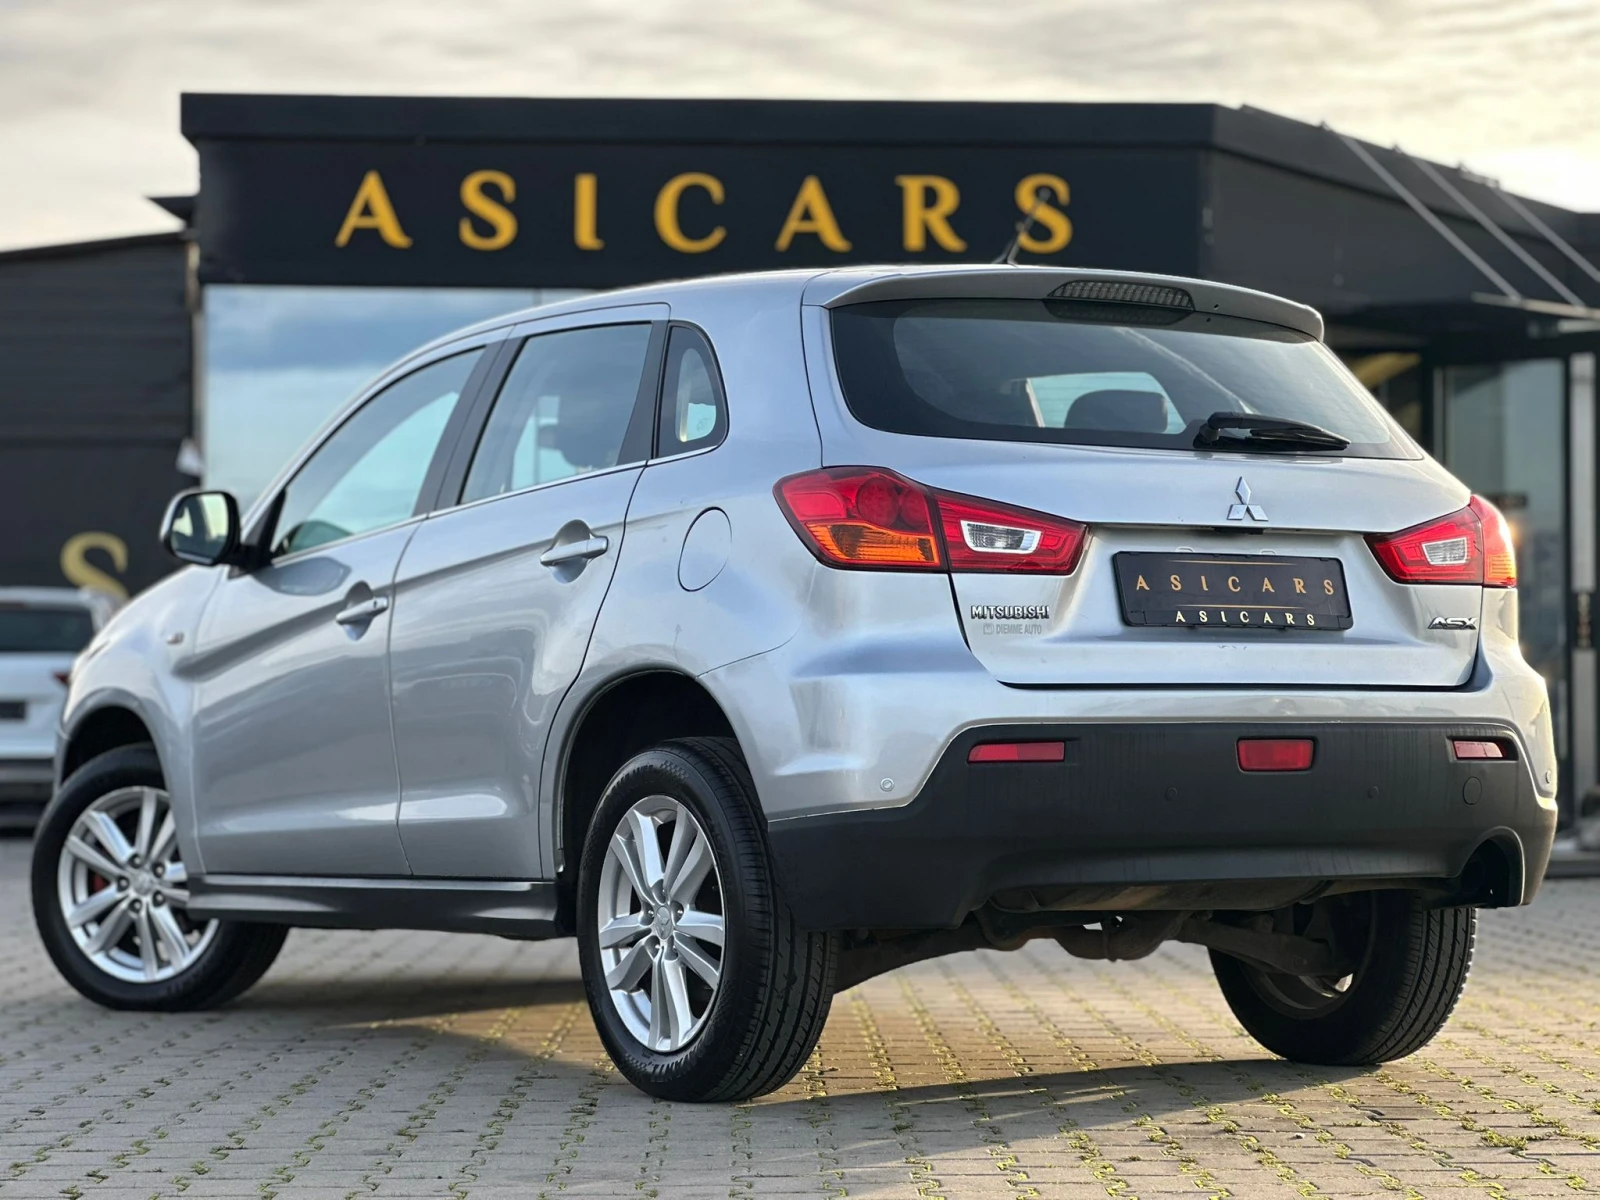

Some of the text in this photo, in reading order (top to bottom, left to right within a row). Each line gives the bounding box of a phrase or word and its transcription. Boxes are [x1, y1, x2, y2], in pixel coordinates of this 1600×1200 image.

[335, 169, 1074, 255] ASICARS
[1136, 575, 1335, 596] ASICARS
[970, 605, 1050, 619] MITSUBISHI
[1175, 610, 1316, 626] ASICARS
[996, 623, 1043, 635] DIEMME AUTO
[1428, 616, 1477, 630] ASX
